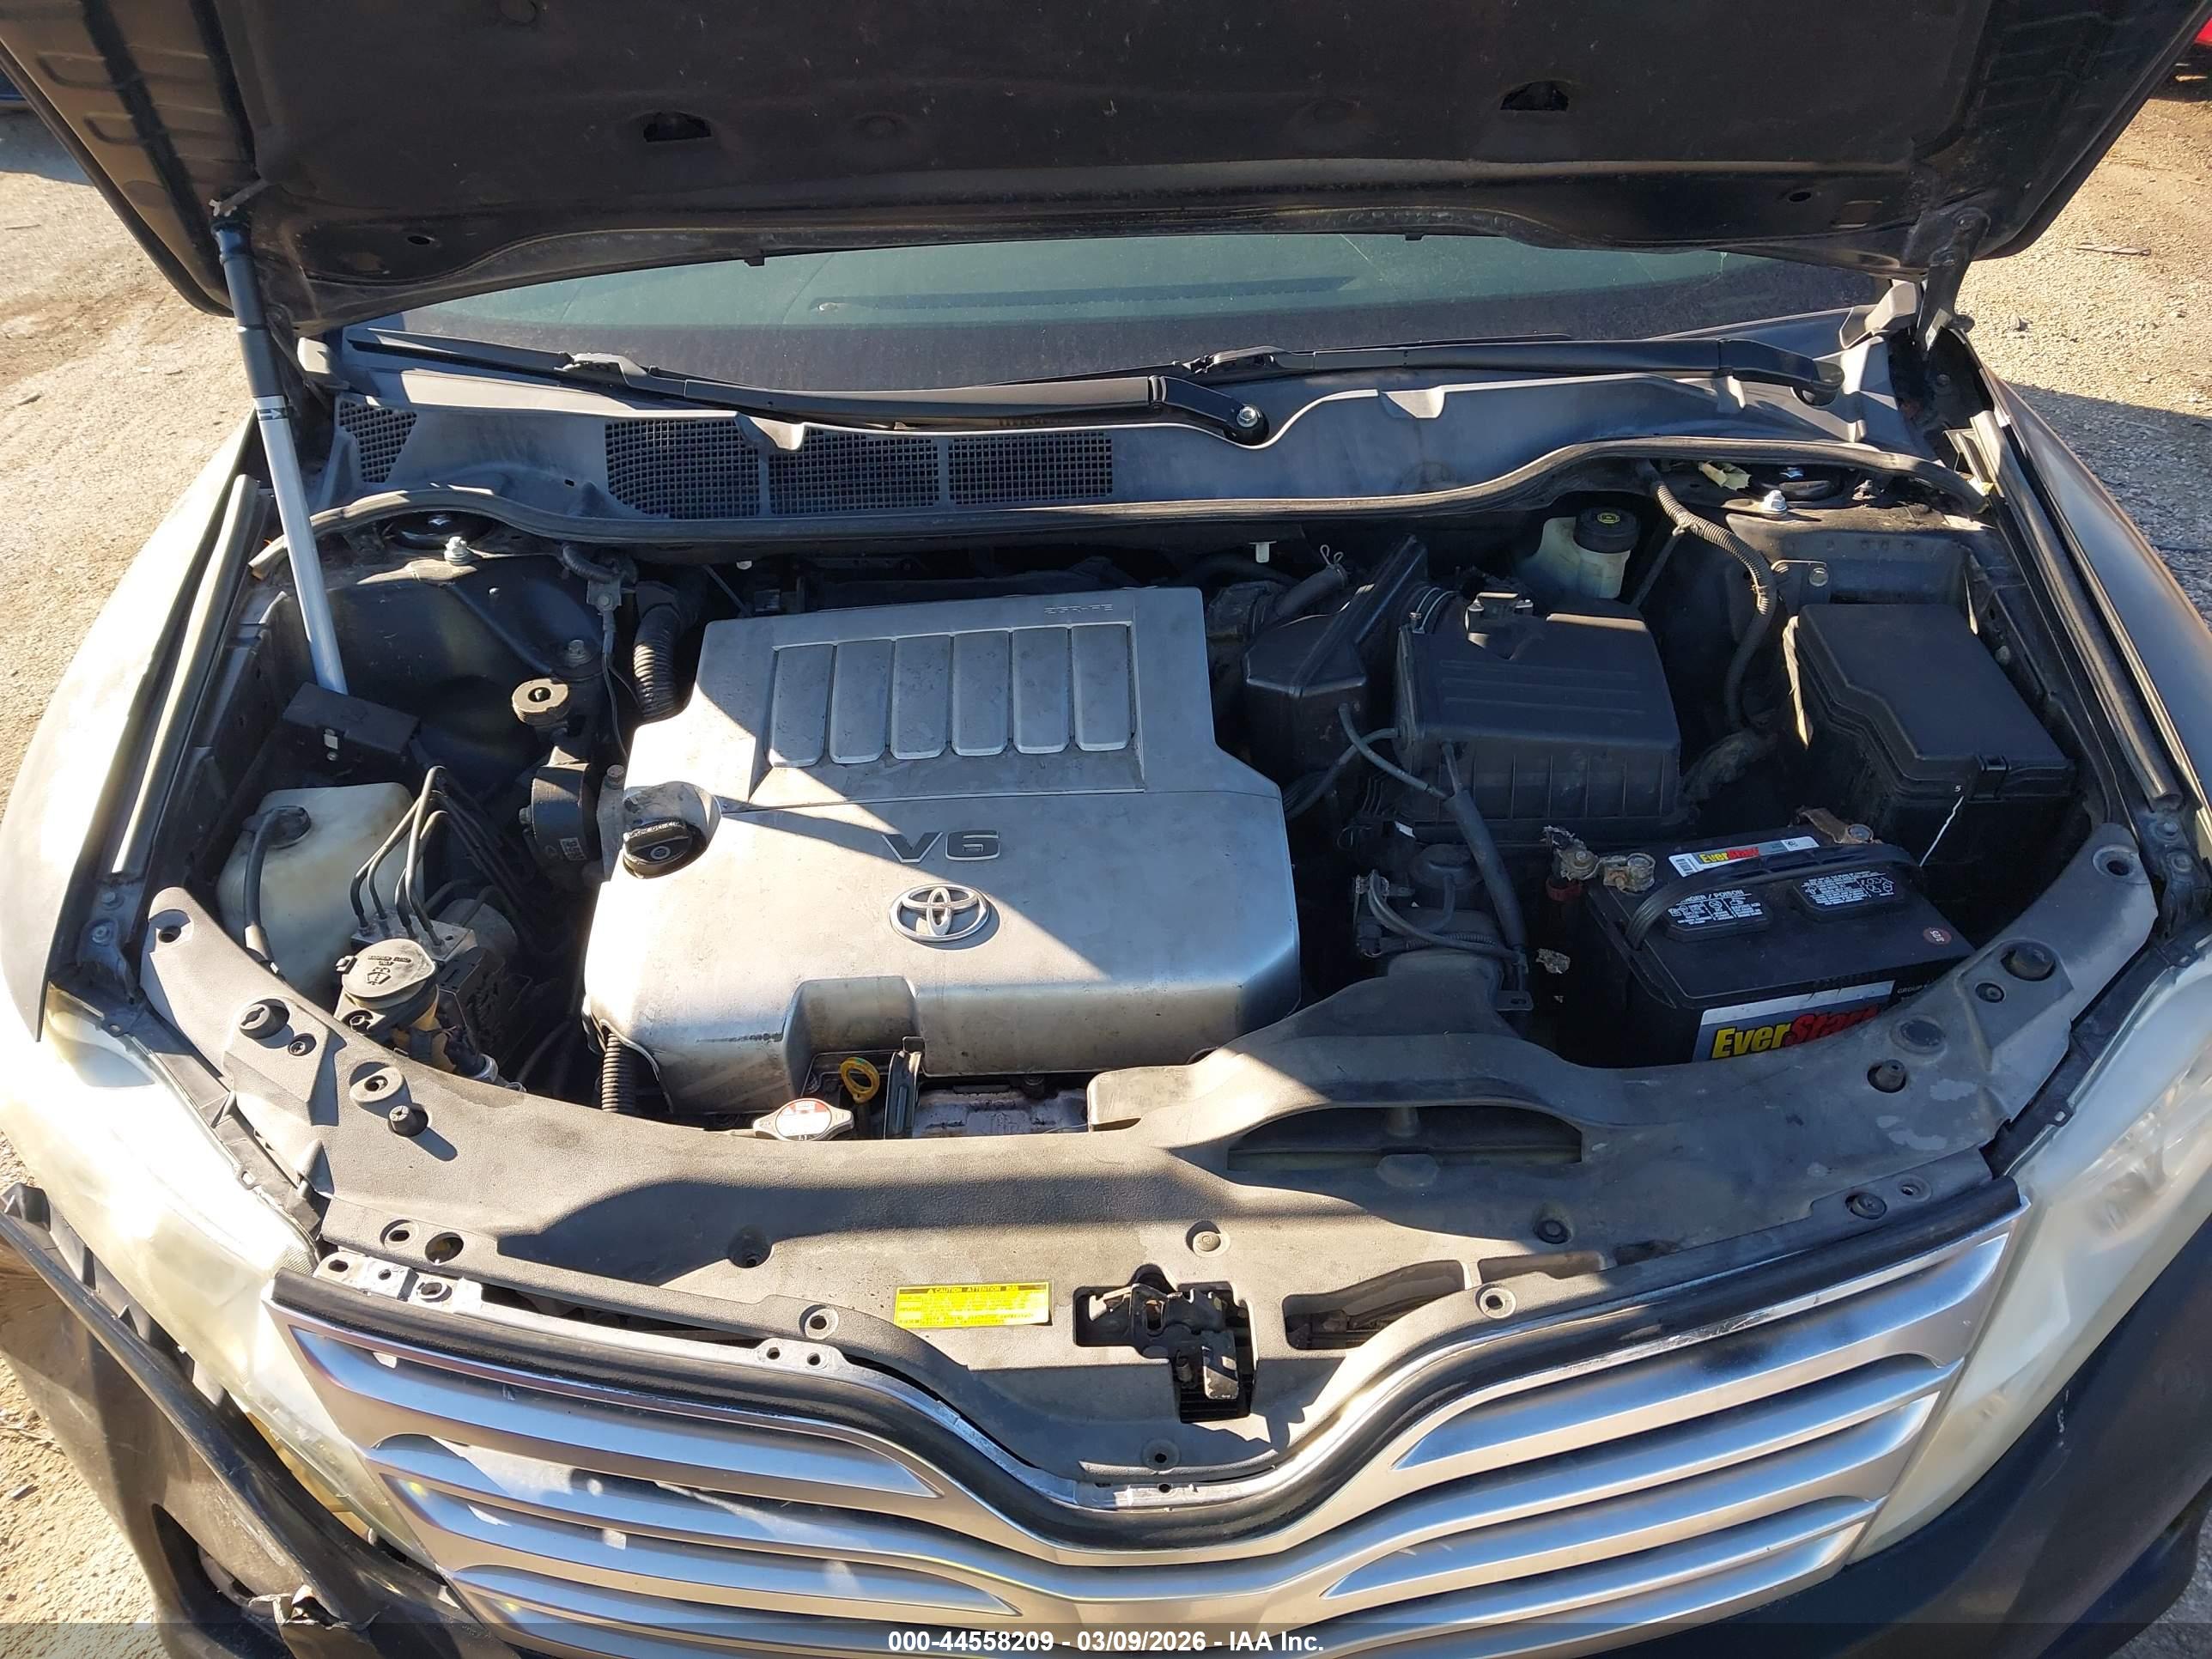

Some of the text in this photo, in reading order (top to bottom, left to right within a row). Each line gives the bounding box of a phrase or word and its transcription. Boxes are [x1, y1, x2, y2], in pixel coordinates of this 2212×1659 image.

[881, 830, 1001, 864] V6
[1698, 846, 1759, 865] EverStart
[1713, 889, 1745, 899] POISON
